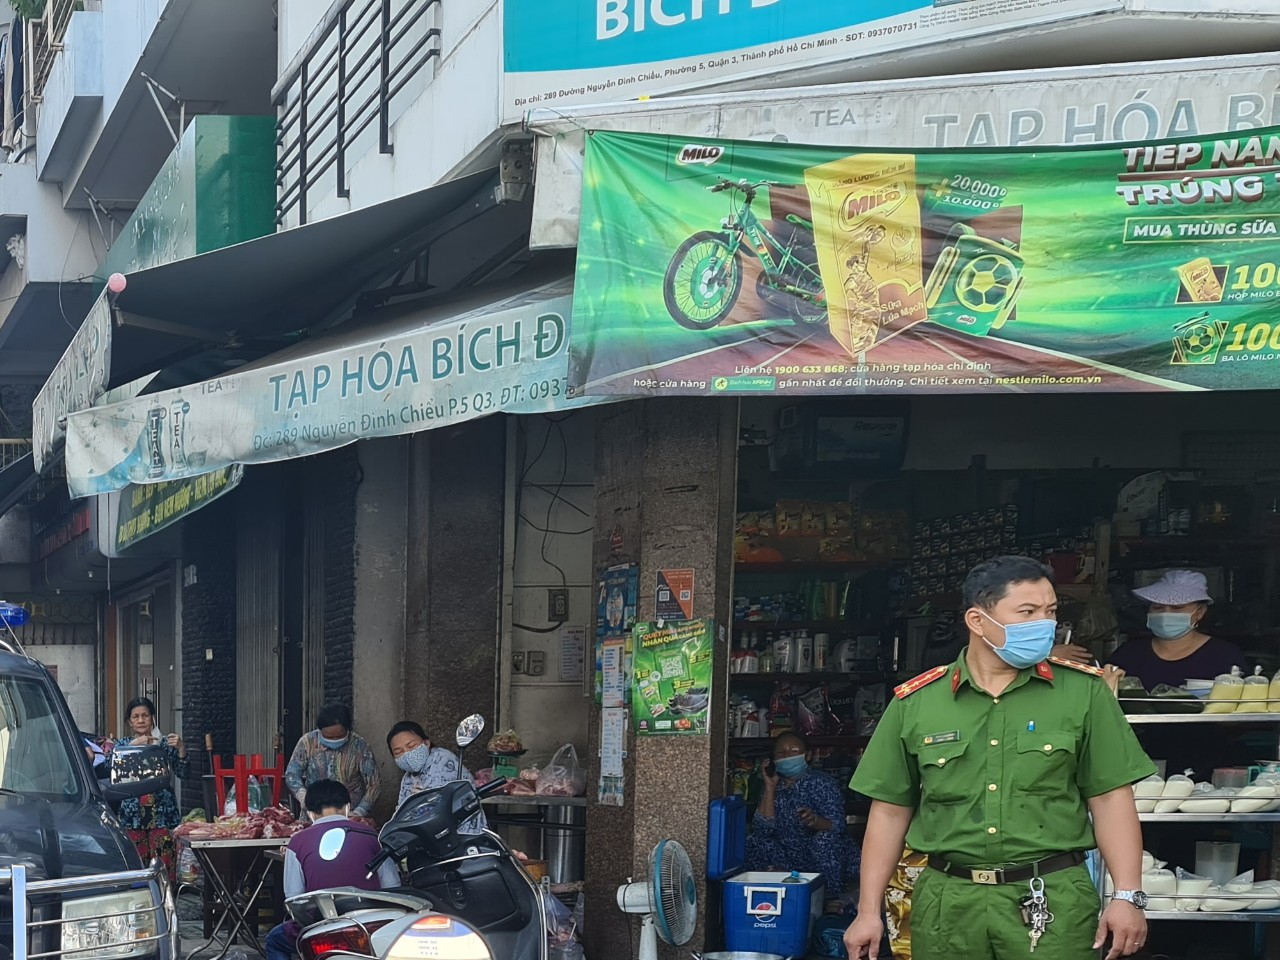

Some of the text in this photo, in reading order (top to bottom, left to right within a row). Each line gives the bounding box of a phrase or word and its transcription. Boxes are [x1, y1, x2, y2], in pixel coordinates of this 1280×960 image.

[544, 91, 557, 100] 289
[817, 37, 838, 48] Minh
[868, 22, 917, 38] 0937070731
[681, 146, 720, 162] MILO
[1116, 176, 1264, 206] TRÚNG
[848, 190, 903, 220] MILO
[1134, 219, 1276, 237] MUA THÙNG SỮA
[1231, 262, 1280, 290] 10
[1228, 290, 1274, 300] HỘP MILO
[269, 312, 570, 420] TẠP HÓA BÍCH Đ
[1237, 353, 1249, 361] LÔ
[735, 365, 757, 374] Liên
[759, 365, 773, 376] hệ
[775, 365, 800, 374] 1900
[802, 365, 822, 374] 633
[872, 363, 900, 374] hàng
[902, 363, 921, 375] tạp
[924, 361, 944, 371] hóa
[679, 379, 706, 390] hàng
[801, 378, 827, 387] nhất
[910, 377, 928, 386] Chi
[930, 376, 949, 386] tiết
[951, 378, 976, 386] xem
[978, 376, 993, 386] tại
[995, 375, 1102, 386] nestlemilo.com.vn
[275, 428, 298, 446] 289
[301, 416, 357, 443] Nguyễn
[448, 396, 469, 417] P.5
[500, 385, 526, 406] ĐT:
